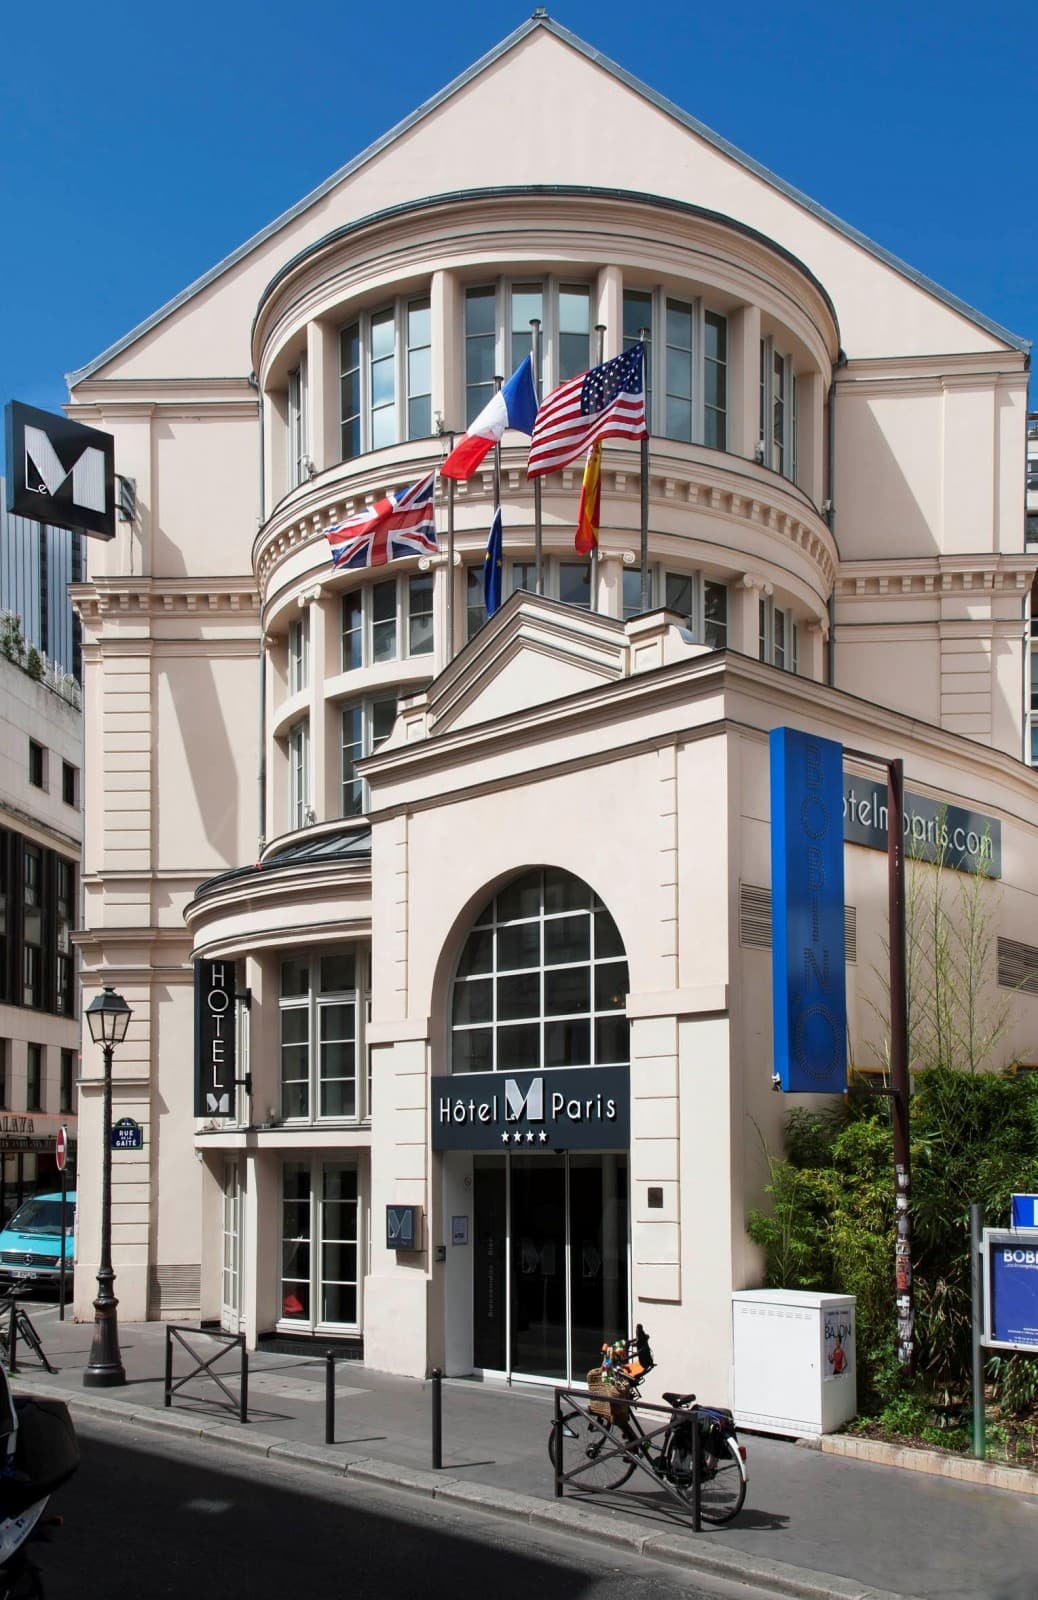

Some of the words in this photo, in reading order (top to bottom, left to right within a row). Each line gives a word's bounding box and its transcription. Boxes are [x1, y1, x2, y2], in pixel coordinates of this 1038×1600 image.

[24, 424, 106, 514] M
[207, 964, 229, 1088] HOTEL
[119, 1129, 134, 1137] RUE
[440, 1095, 497, 1122] Hôtel
[552, 1092, 616, 1120] Paris
